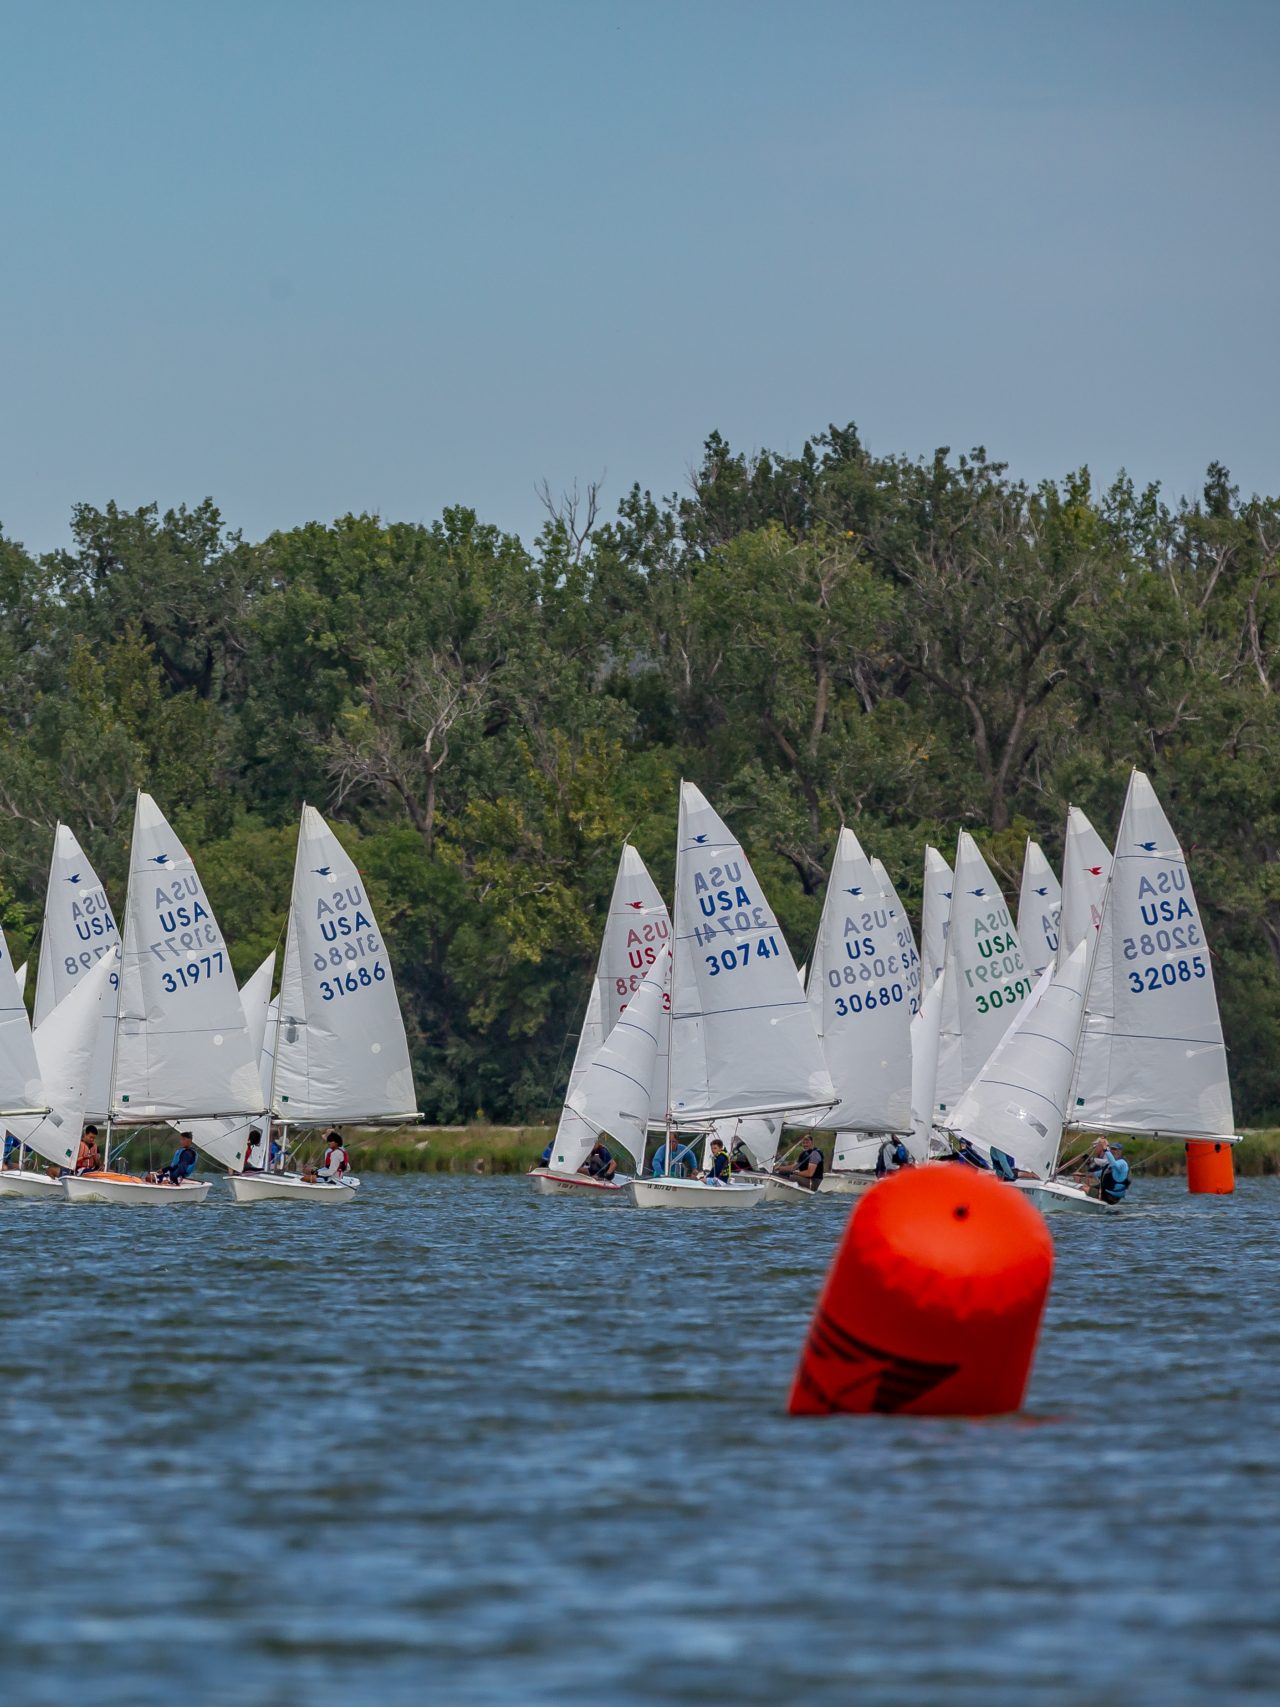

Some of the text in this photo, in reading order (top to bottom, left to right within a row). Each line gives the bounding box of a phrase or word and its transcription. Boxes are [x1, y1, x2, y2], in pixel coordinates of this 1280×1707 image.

[159, 901, 208, 933] USA
[699, 886, 751, 916] USA
[1140, 897, 1193, 926] USA
[76, 913, 115, 940] USA
[320, 911, 371, 941] USA
[705, 936, 780, 976] 30741
[901, 948, 919, 969] SA
[977, 932, 1018, 958] USA
[162, 952, 223, 992] 31977
[320, 961, 385, 1000] 31686
[1128, 956, 1206, 993] 32085
[835, 984, 903, 1016] 30680
[975, 978, 1032, 1013] 30391
